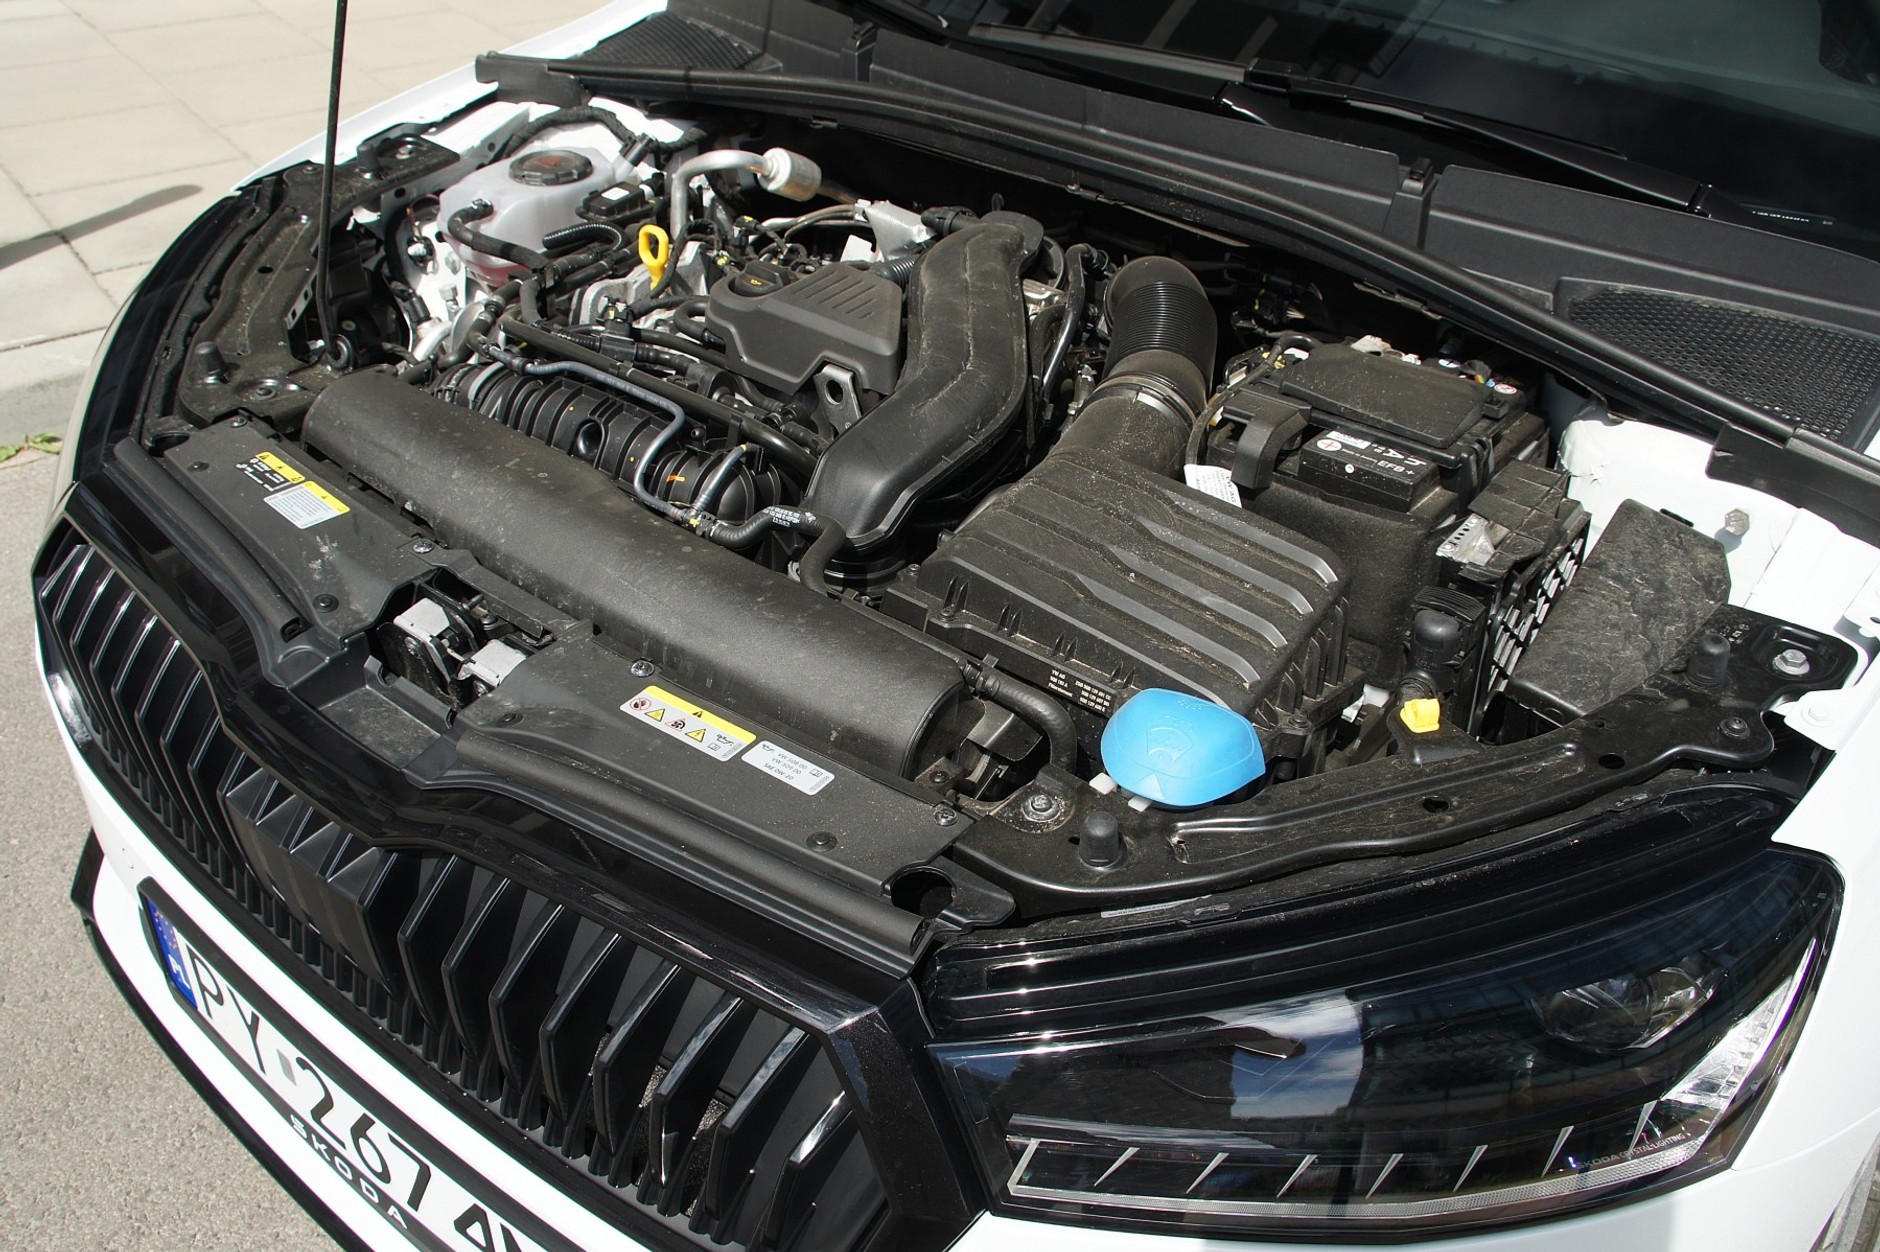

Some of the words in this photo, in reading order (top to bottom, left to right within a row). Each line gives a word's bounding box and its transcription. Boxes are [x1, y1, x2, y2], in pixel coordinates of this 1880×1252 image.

[168, 953, 190, 990] PL
[186, 944, 266, 1075] PY
[296, 1057, 522, 1252] 2674
